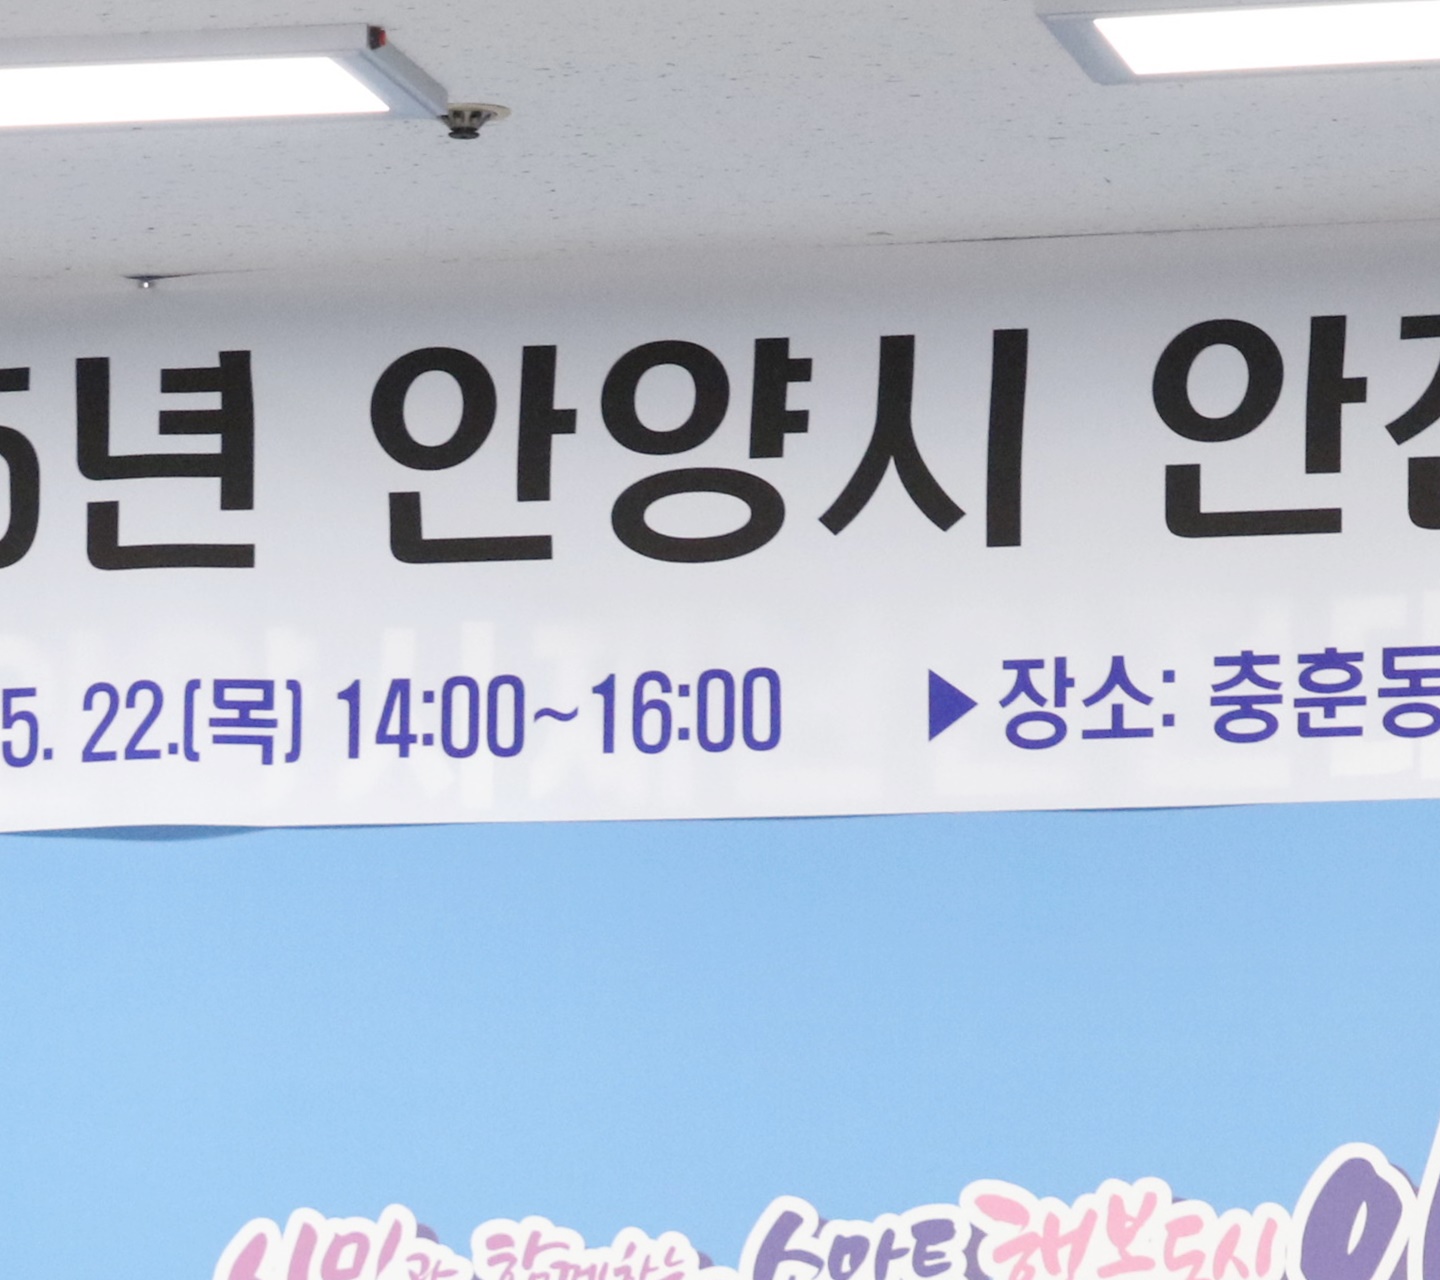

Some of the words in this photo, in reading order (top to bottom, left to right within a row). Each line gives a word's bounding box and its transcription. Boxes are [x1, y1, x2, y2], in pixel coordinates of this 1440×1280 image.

[368, 326, 1032, 567] 안양시
[0, 686, 55, 769] 5.
[335, 666, 783, 761] 14:00~16:00
[998, 654, 1177, 752] 장소:
